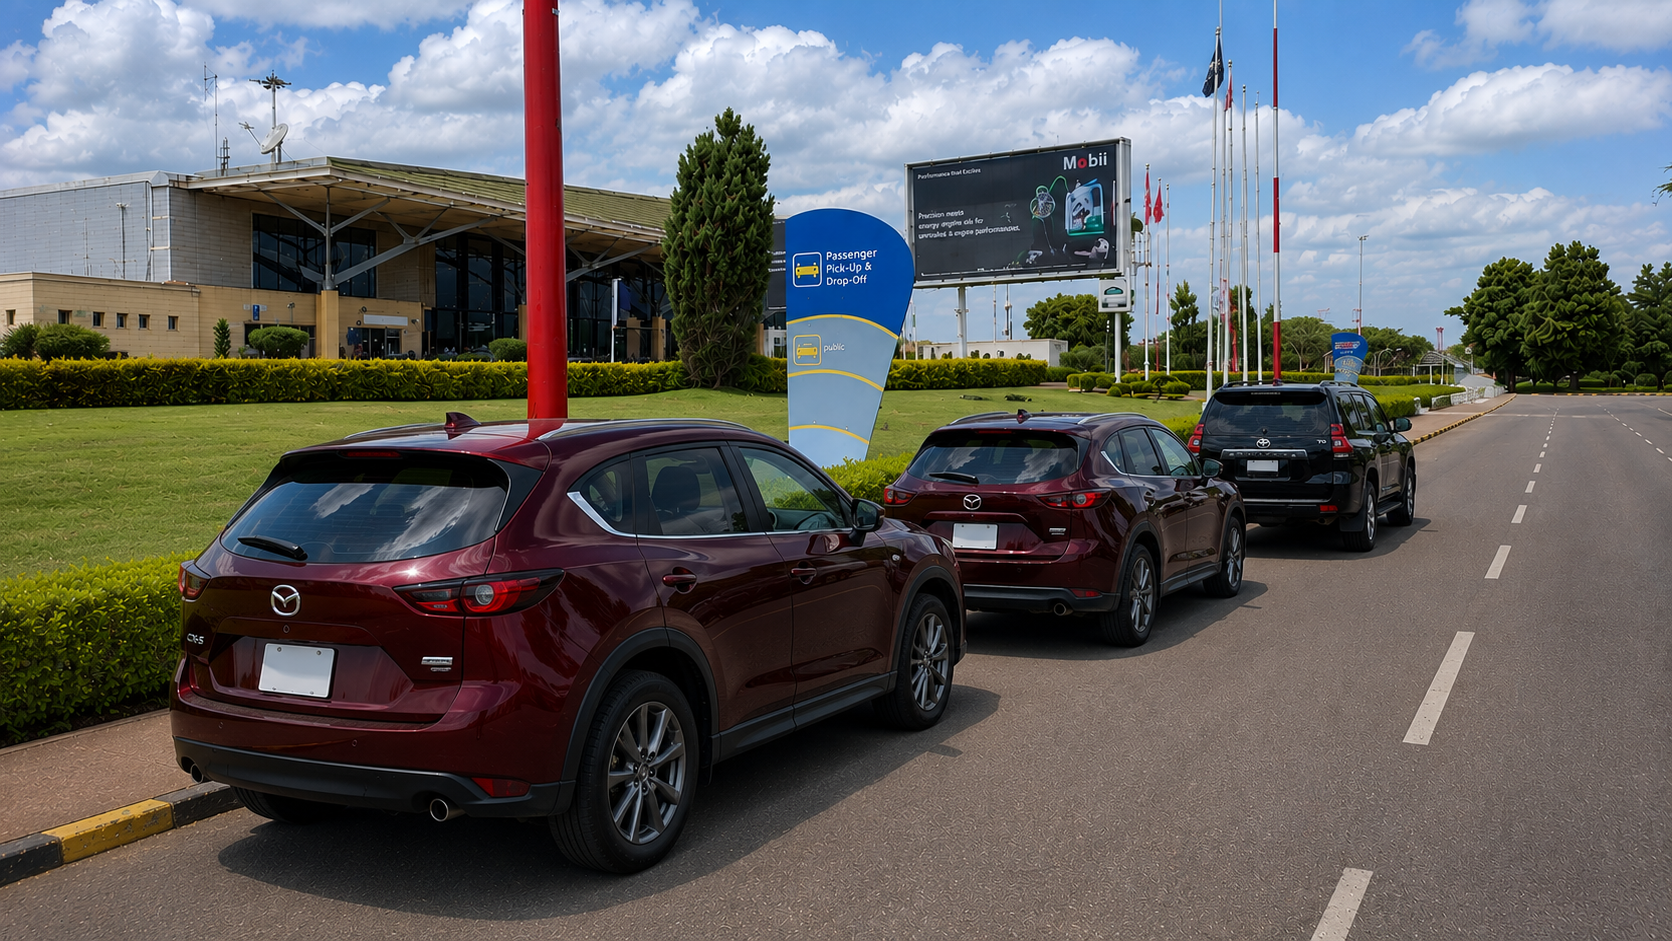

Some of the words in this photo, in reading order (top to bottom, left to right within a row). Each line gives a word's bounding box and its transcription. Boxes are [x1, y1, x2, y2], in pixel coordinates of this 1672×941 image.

[1063, 152, 1107, 170] Mobii
[826, 249, 877, 261] Passenger
[826, 263, 862, 274] Pick-Up
[865, 262, 872, 271] &
[826, 274, 867, 287] Drop-Off
[823, 343, 845, 353] public
